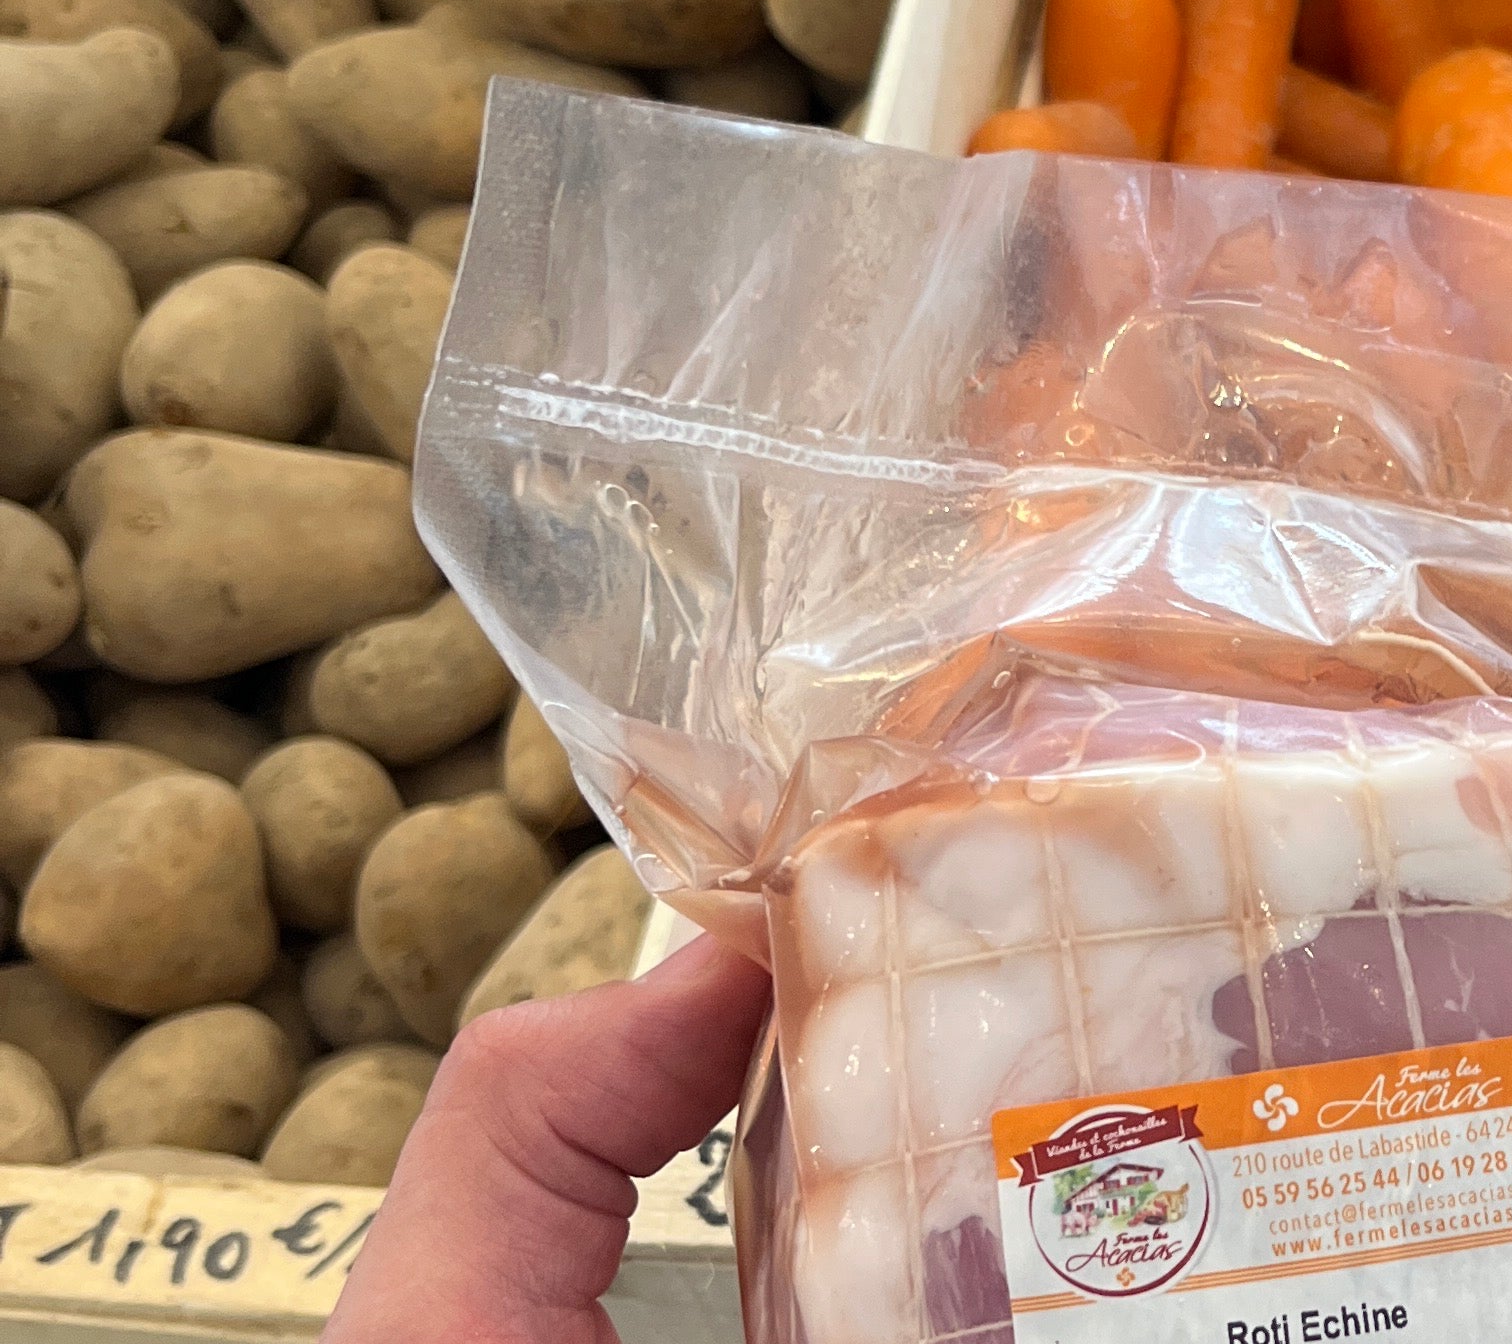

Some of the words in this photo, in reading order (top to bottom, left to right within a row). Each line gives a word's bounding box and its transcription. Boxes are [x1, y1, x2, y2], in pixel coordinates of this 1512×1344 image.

[1395, 1064, 1451, 1087] Ferme
[1456, 1056, 1482, 1077] les
[1317, 1074, 1503, 1129] Acacias
[1046, 1135, 1088, 1157] Viandes
[1089, 1132, 1101, 1145] et
[1078, 1147, 1092, 1161] de
[1106, 1137, 1142, 1155] Ferme
[1232, 1152, 1267, 1178] 210
[1272, 1146, 1324, 1172] route
[1329, 1139, 1354, 1163] de
[1358, 1126, 1450, 1160] Labastide
[1242, 1185, 1268, 1209] 05
[1274, 1181, 1299, 1205] 59
[1306, 1176, 1334, 1200] 56
[1339, 1171, 1367, 1195] 25
[1373, 1166, 1400, 1189] 44
[1417, 1159, 1445, 1184] 06
[1451, 1154, 1475, 1178] 19
[1481, 1149, 1508, 1174] 28
[36, 1208, 251, 1286] 1,90
[1065, 1238, 1183, 1273] Acacias
[1301, 1302, 1408, 1343] Echine
